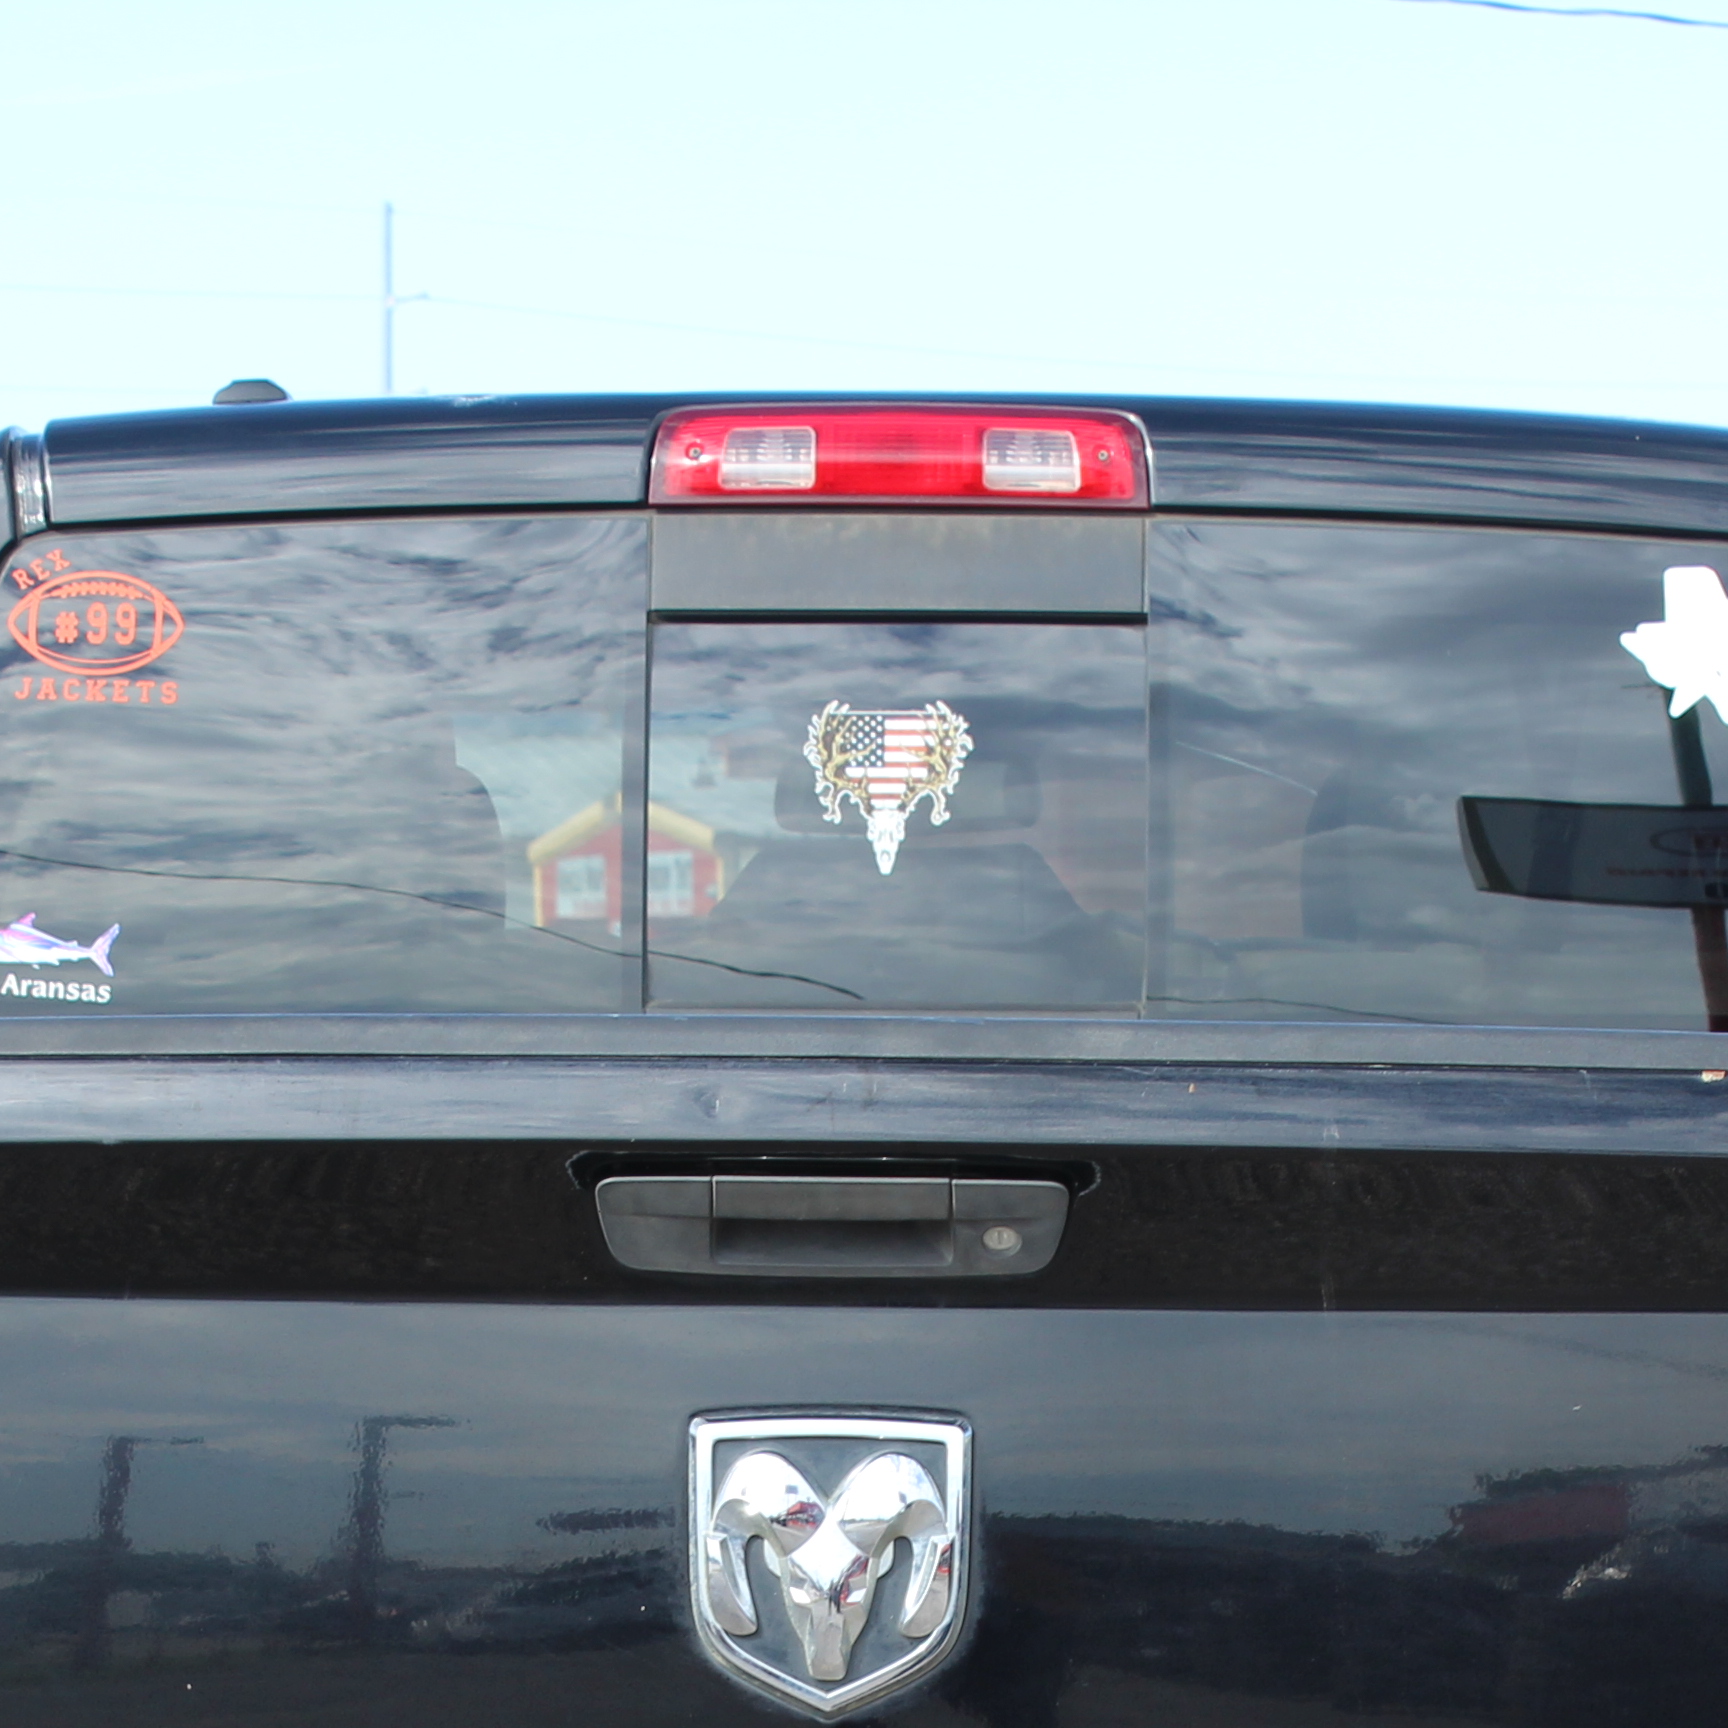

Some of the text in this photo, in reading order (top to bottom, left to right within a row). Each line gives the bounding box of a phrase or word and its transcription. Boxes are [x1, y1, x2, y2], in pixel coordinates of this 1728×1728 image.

[11, 548, 71, 590] REX
[54, 602, 138, 645] #99
[14, 677, 179, 704] JACKETS
[0, 972, 113, 1004] Aransas
